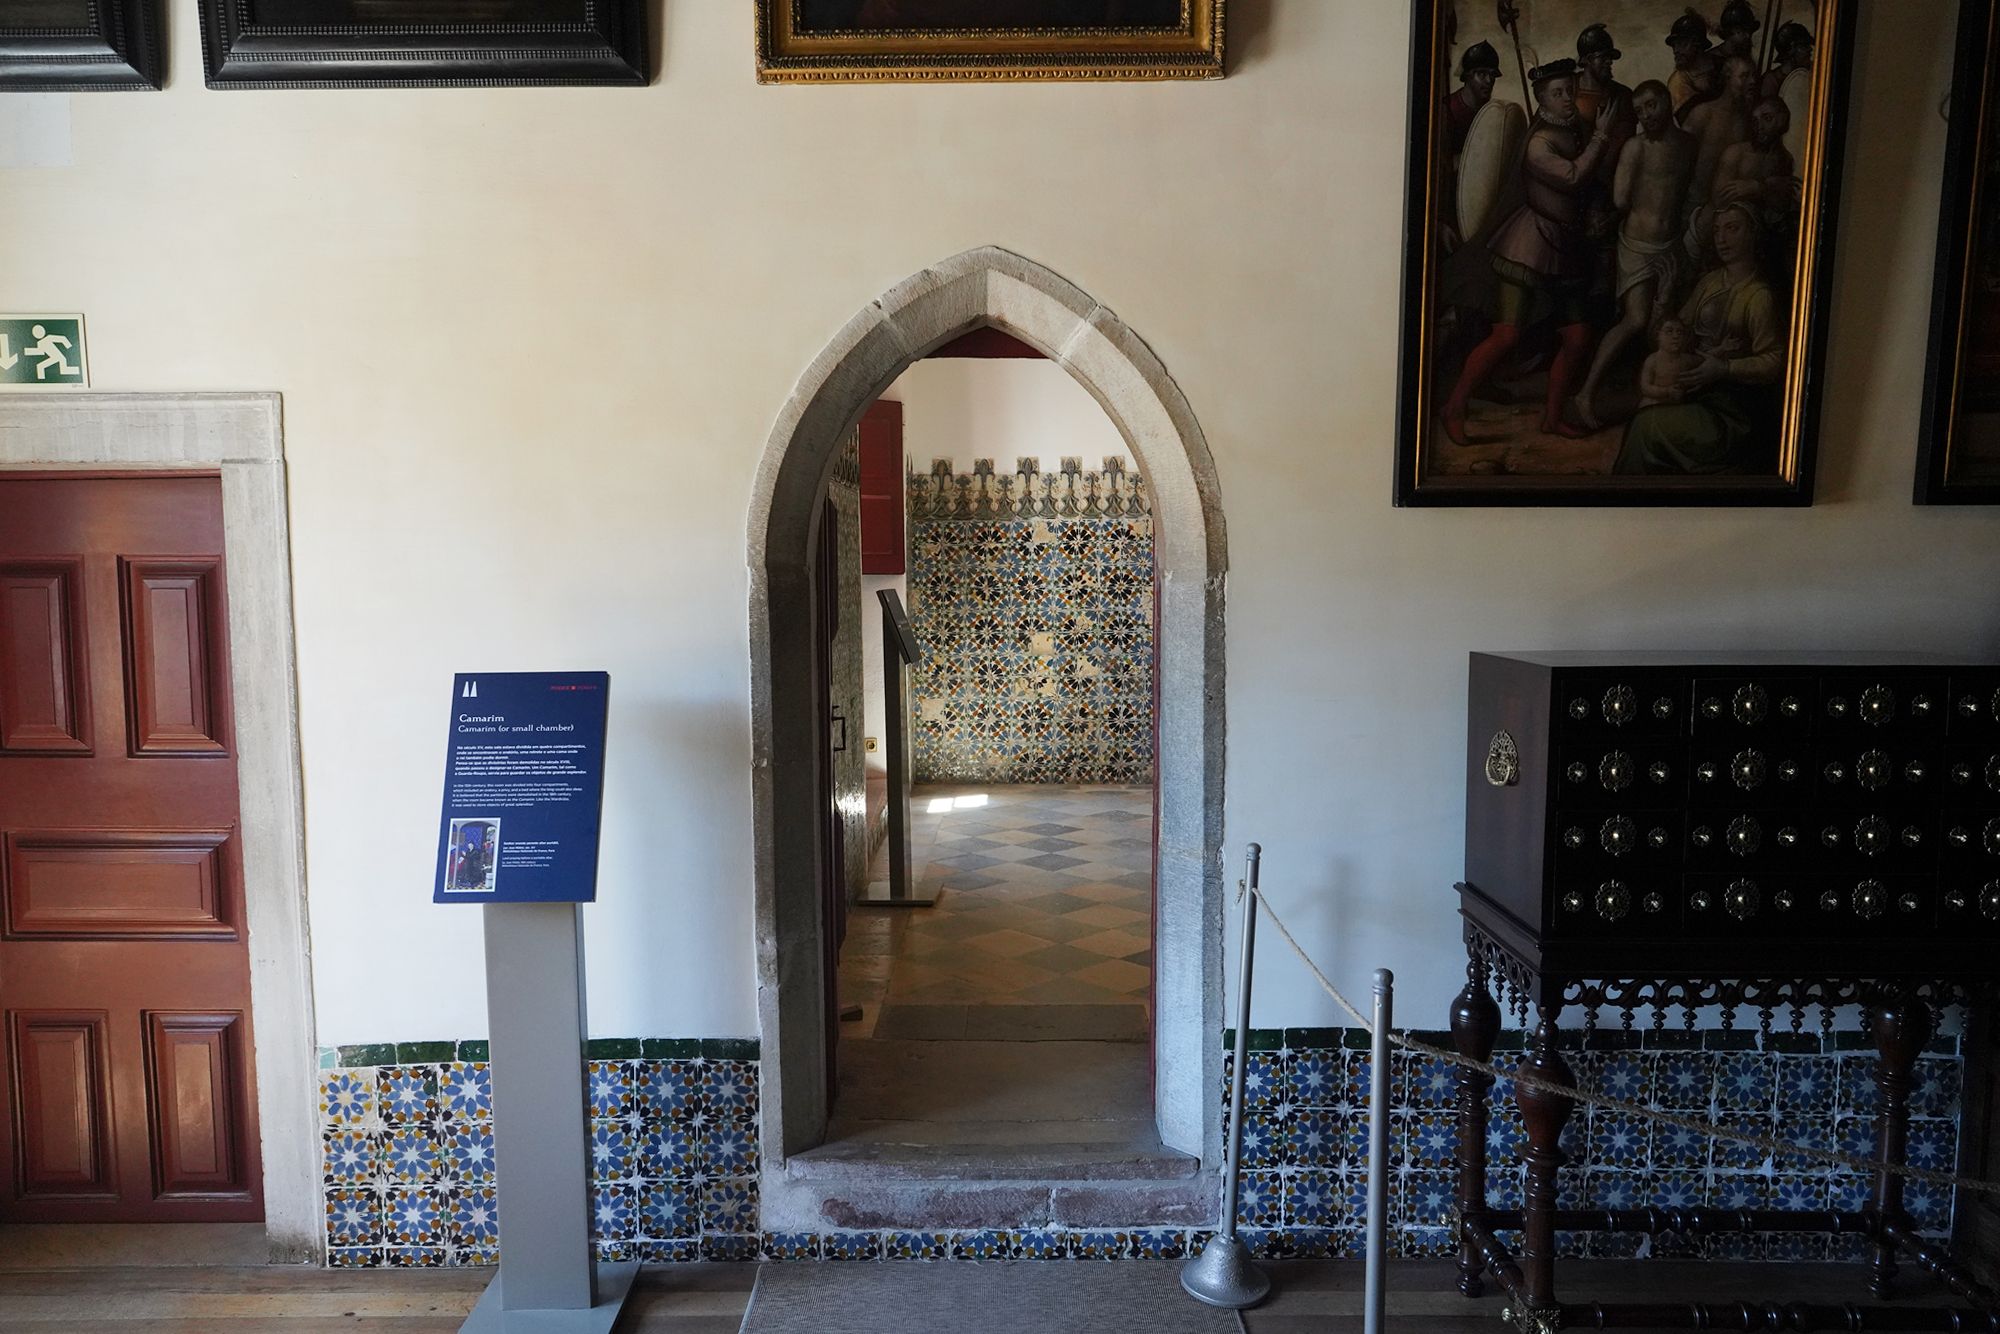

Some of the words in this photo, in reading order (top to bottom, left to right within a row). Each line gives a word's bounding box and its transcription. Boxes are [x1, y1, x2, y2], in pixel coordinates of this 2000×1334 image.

[459, 714, 504, 722] Camarim
[458, 725, 496, 733] Camarim
[498, 724, 510, 733] (or
[512, 724, 534, 732] small
[536, 724, 574, 732] chamber)
